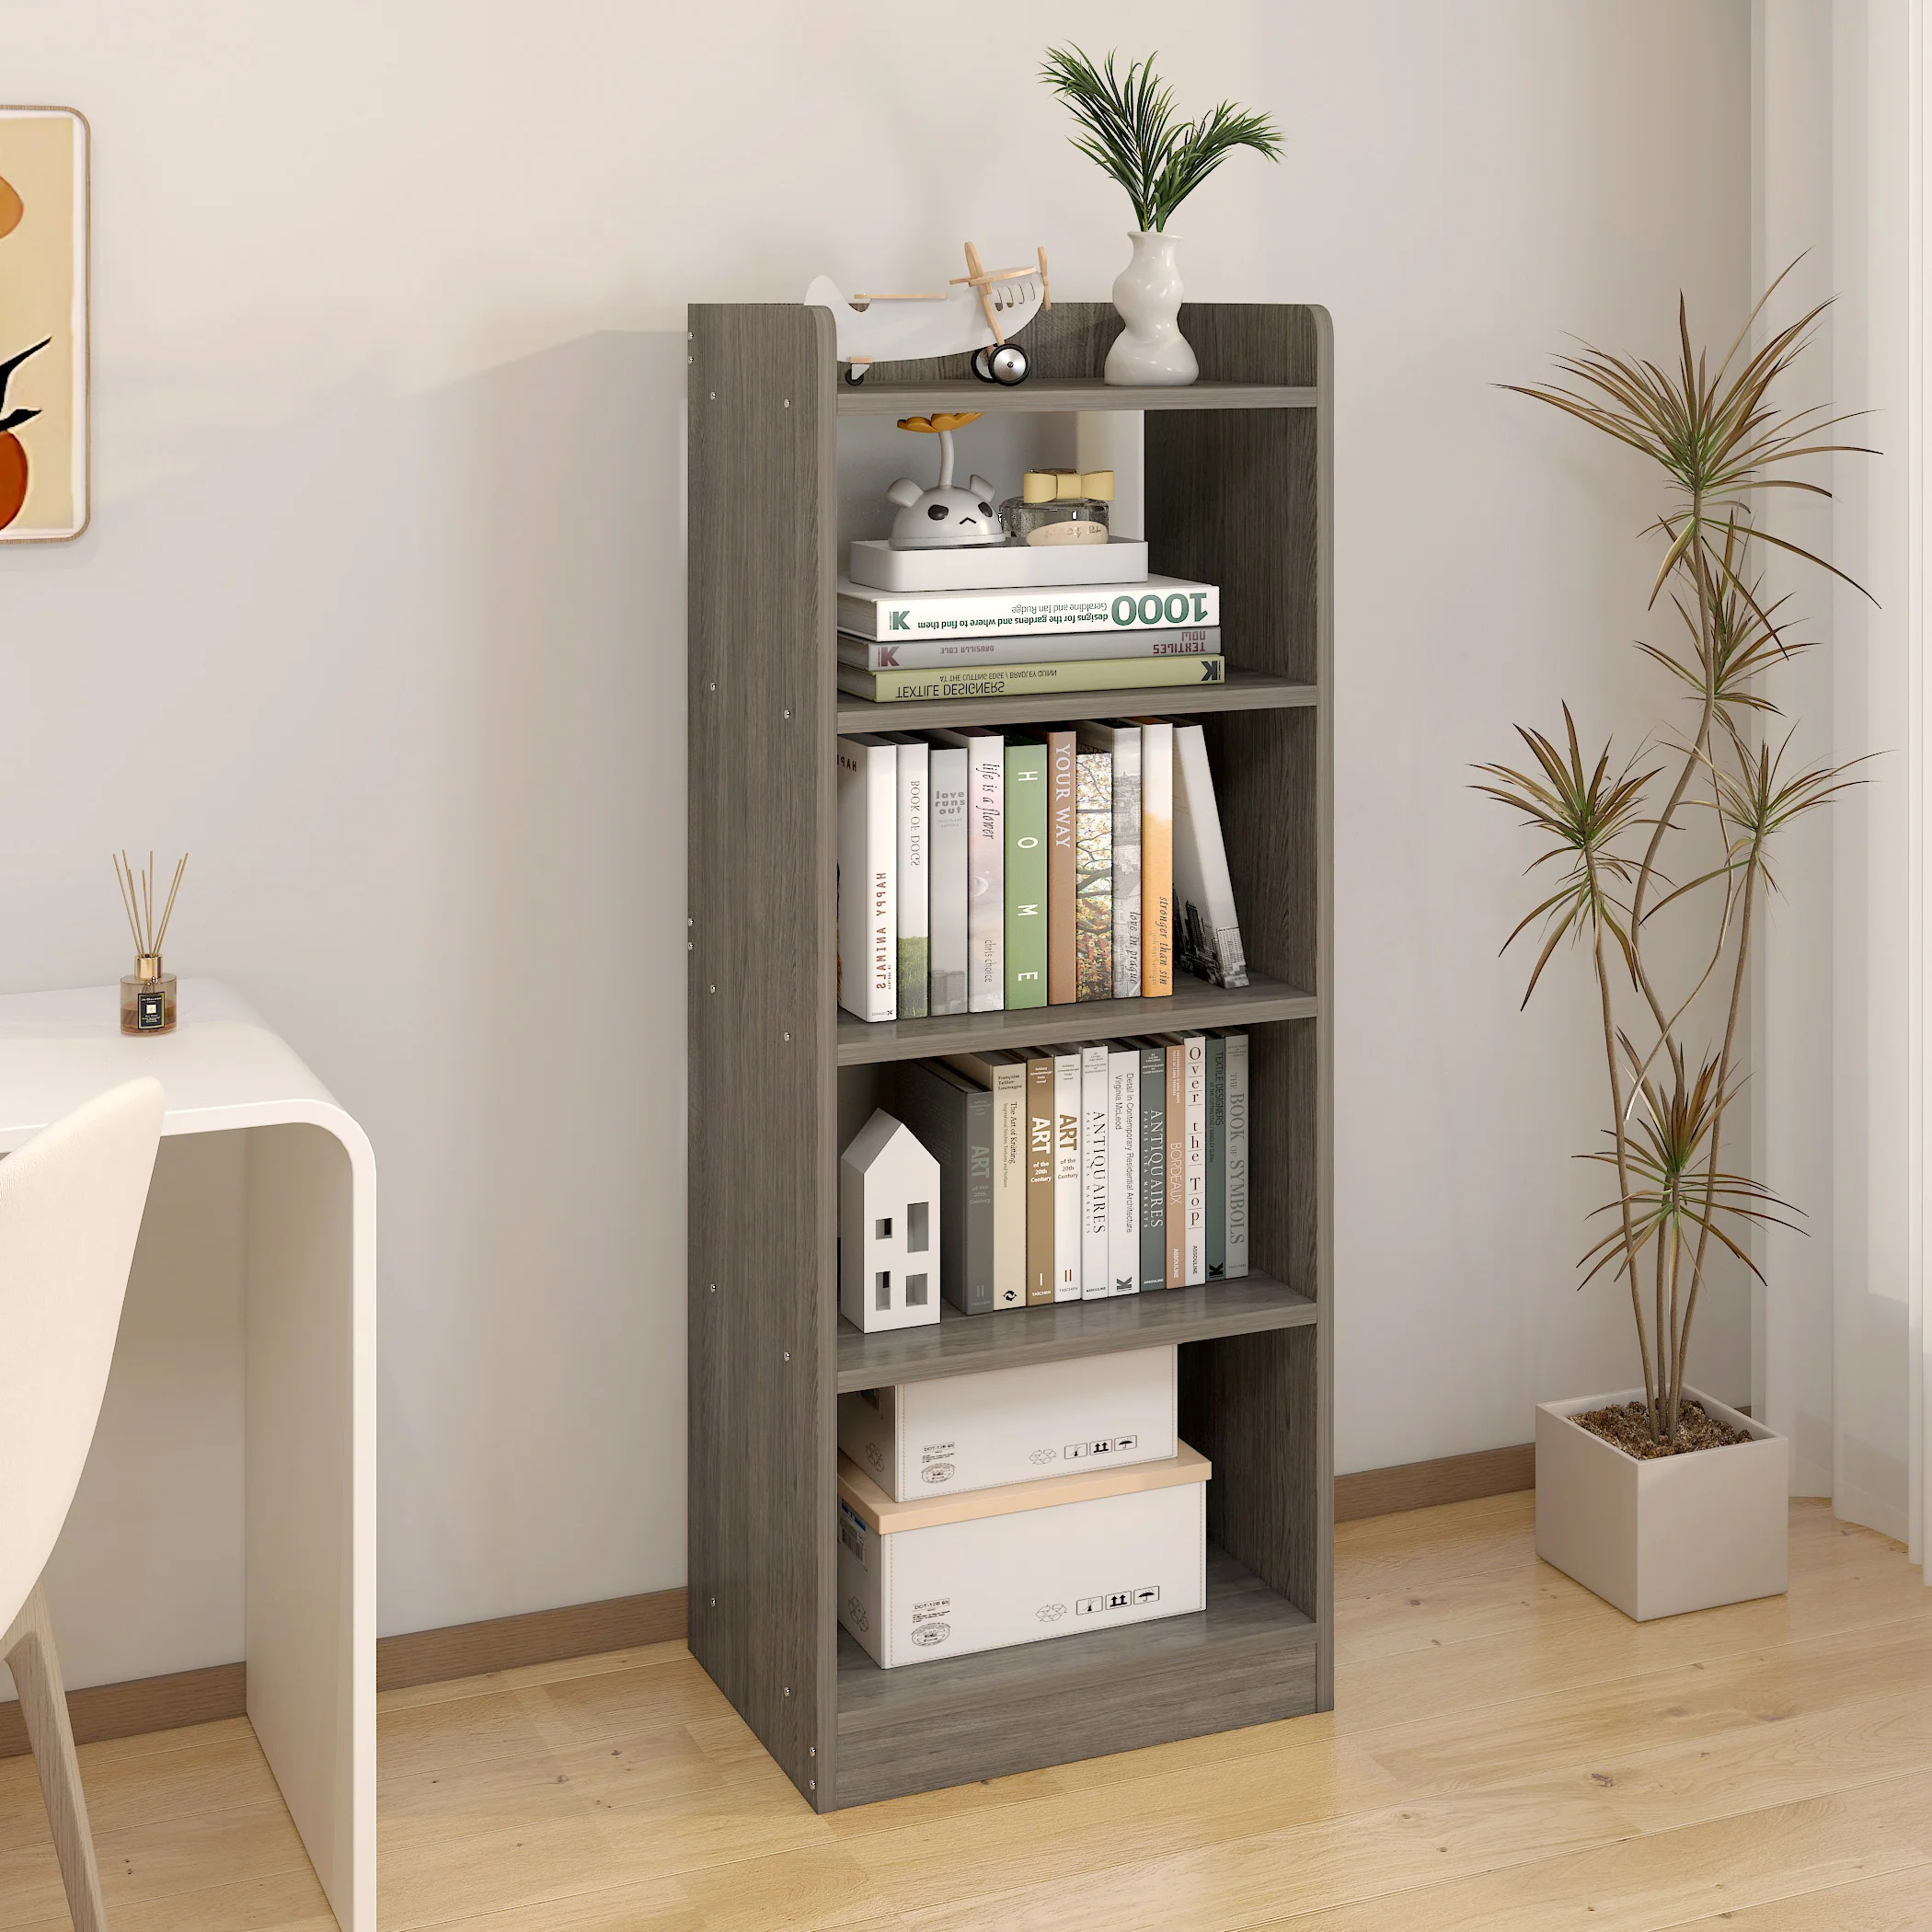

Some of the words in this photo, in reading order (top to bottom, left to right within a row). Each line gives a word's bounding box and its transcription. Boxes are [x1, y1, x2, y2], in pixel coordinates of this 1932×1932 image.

[1012, 604, 1037, 615] Rudge
[1015, 615, 1047, 627] gardens
[1039, 605, 1052, 614] Ian
[1049, 615, 1062, 625] the
[1053, 604, 1068, 614] and
[1064, 615, 1075, 624] for
[1070, 603, 1107, 613] Geraldine
[1077, 613, 1108, 624] designs
[1111, 593, 1208, 627] 1000
[941, 620, 958, 629] find
[971, 619, 995, 627] where
[998, 618, 1013, 627] and
[1153, 642, 1205, 654] TEXTILES
[976, 764, 1000, 780] life
[1055, 743, 1071, 801] YOUR
[983, 784, 995, 792] is
[975, 804, 1000, 840] flower
[1056, 807, 1070, 849] WAY
[1018, 770, 1038, 981] HOME
[1130, 912, 1141, 931] love
[1156, 897, 1168, 938] stronger
[984, 939, 996, 957] chris
[1130, 937, 1138, 946] in
[1159, 943, 1171, 965] than
[984, 959, 996, 983] choice
[1125, 950, 1138, 984] prague
[1159, 970, 1169, 985] sin
[1190, 1046, 1202, 1103] Over
[1215, 1052, 1224, 1082] TEXTILE
[1113, 1075, 1122, 1101] Virginia
[1215, 1083, 1224, 1126] DESIGNERS
[1230, 1093, 1245, 1142] BOOK
[1032, 1117, 1051, 1155] ART
[1060, 1114, 1077, 1150] ART
[1124, 1102, 1133, 1151] Contemporary
[1008, 1137, 1018, 1164] Knitting
[1190, 1122, 1200, 1162] the
[1230, 1145, 1236, 1156] OF
[972, 1145, 990, 1178] ART
[1090, 1111, 1106, 1234] ANTIQUAIRES
[1148, 1110, 1164, 1227] ANTIQUAIRES
[1170, 1143, 1182, 1205] BORDEAUX
[1229, 1159, 1245, 1245] SYMBOLS
